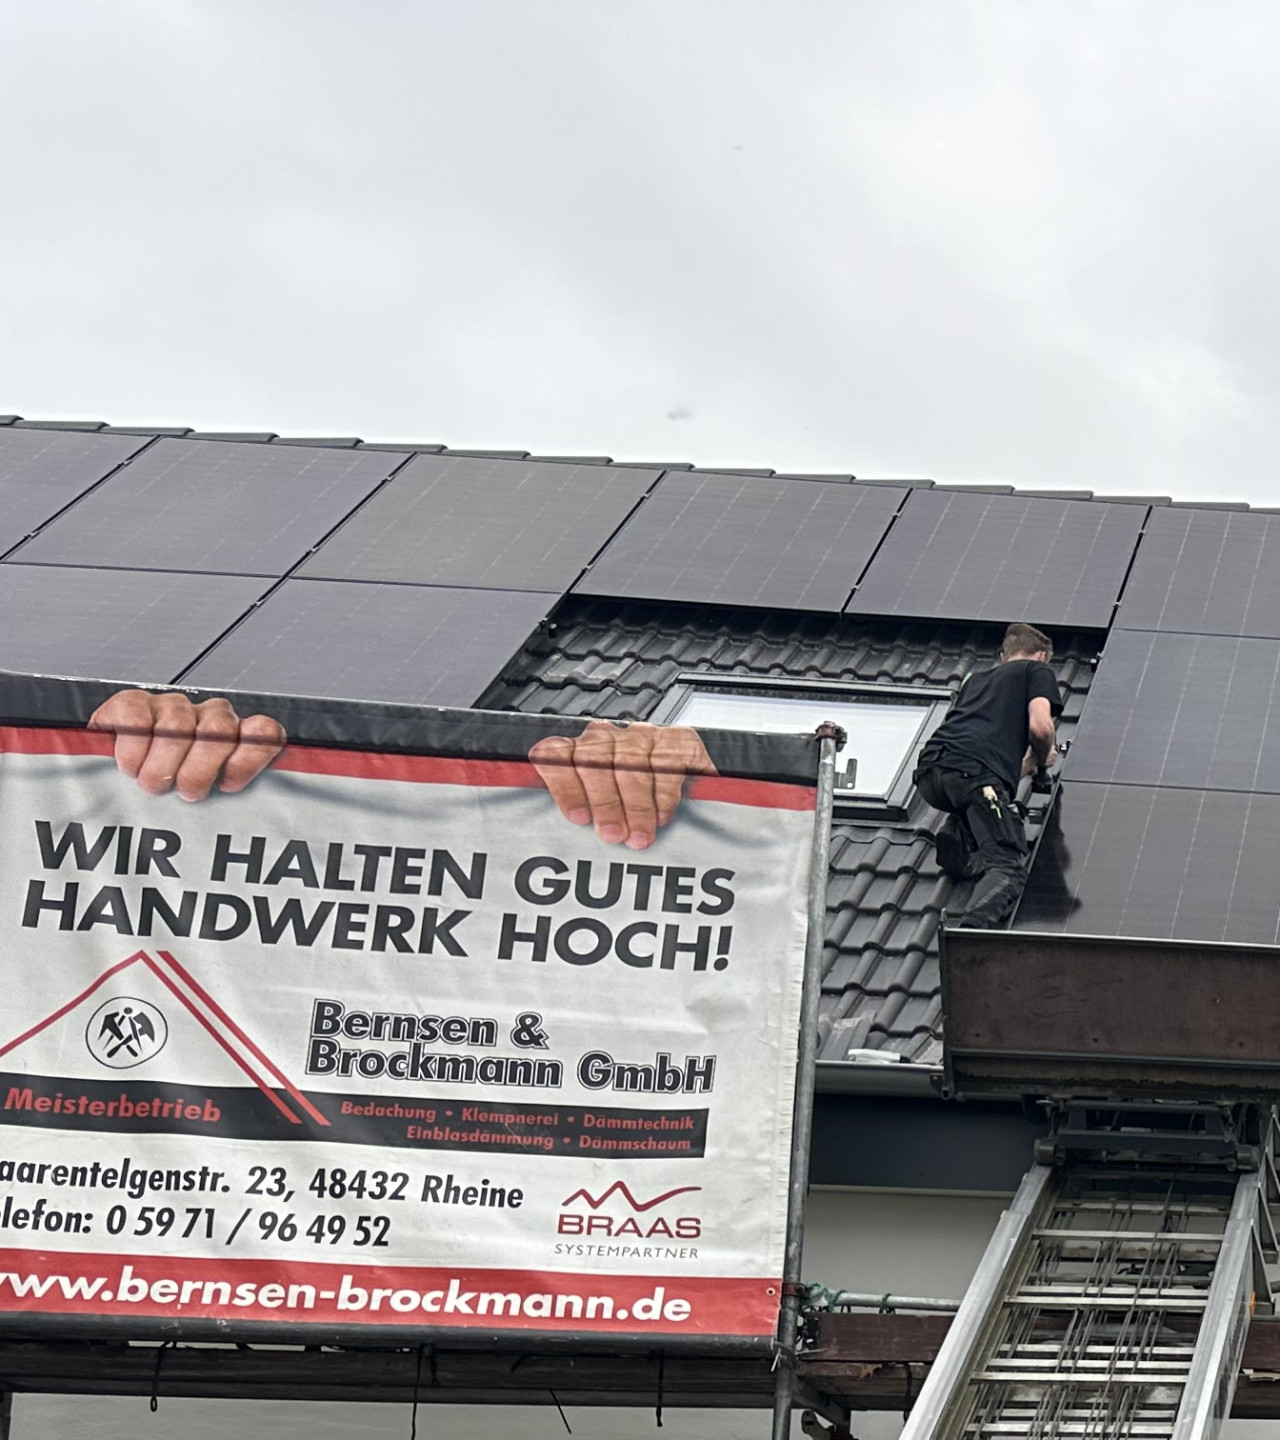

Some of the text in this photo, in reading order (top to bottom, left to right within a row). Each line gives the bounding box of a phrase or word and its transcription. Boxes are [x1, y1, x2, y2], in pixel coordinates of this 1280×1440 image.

[35, 820, 736, 916] WIR HALTEN GUTES
[22, 879, 733, 971] HANDWERK HOCH!
[311, 998, 551, 1050] Bernsen &
[305, 1036, 717, 1095] Brockmann GmbH
[4, 1087, 221, 1122] Meisterbetrieb
[341, 1101, 694, 1131] Bedachung Klempnerei Dämmtechnik
[407, 1125, 691, 1151] Einblasdämmung Dämmschaum
[245, 1166, 295, 1202] 23,
[309, 1168, 409, 1202] 48432
[421, 1174, 524, 1209] Rheine
[0, 1196, 93, 1234] lefon:
[557, 1214, 702, 1240] BRAAS
[554, 1243, 699, 1260] SYSTEMPARTNER
